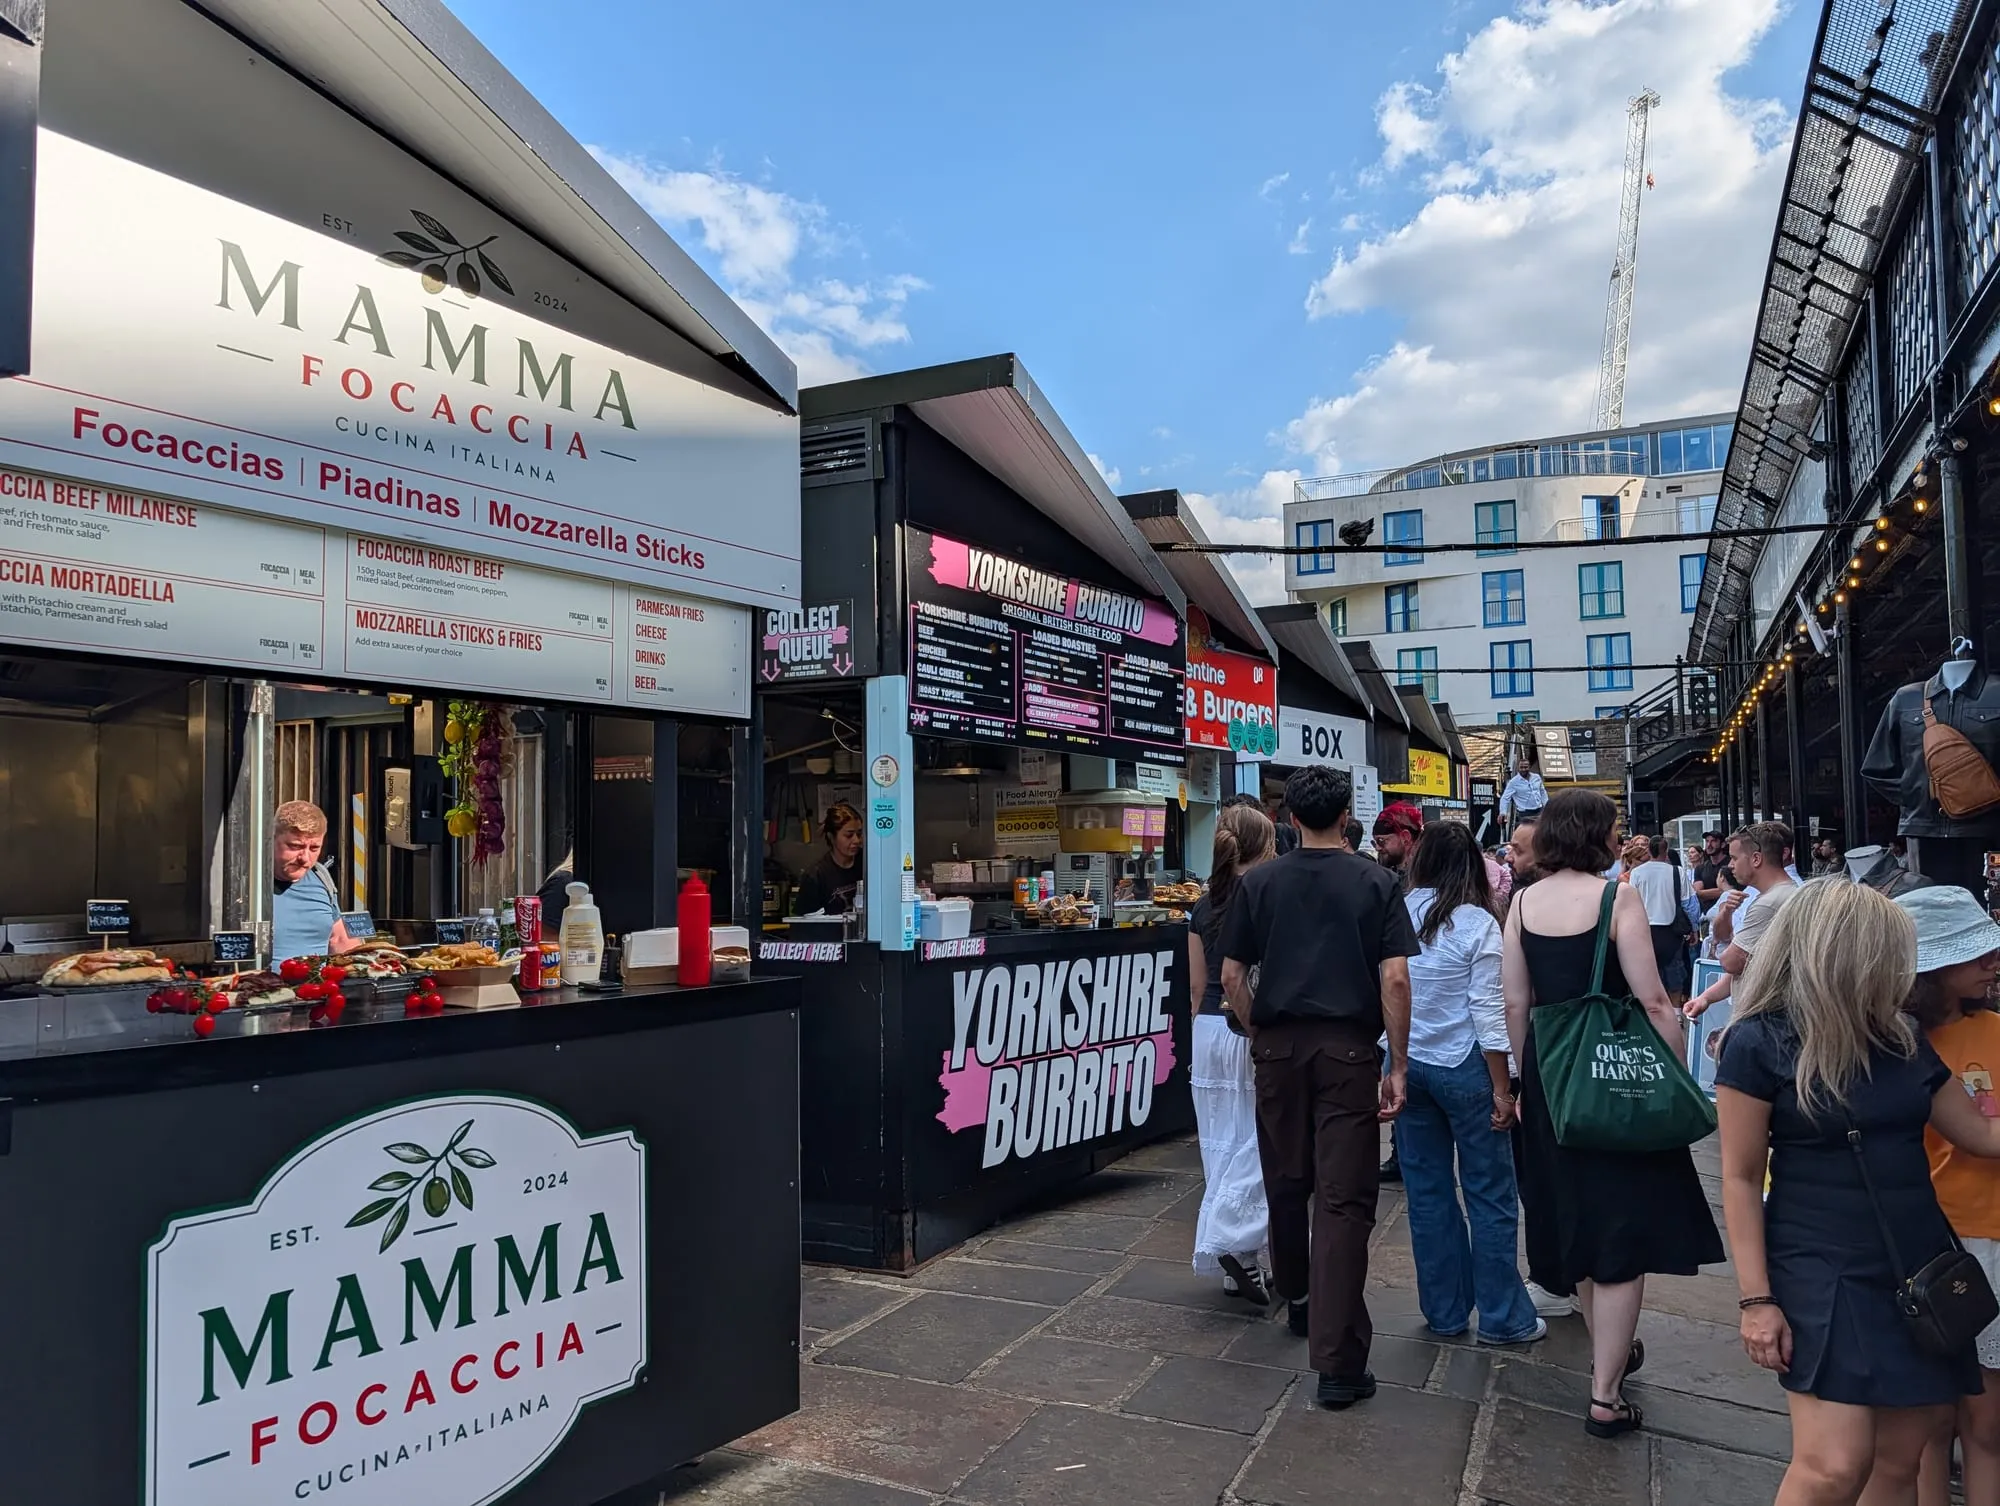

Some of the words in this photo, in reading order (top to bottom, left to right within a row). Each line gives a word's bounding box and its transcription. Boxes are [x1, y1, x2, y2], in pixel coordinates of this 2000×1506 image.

[323, 213, 357, 236] EST.
[534, 292, 568, 313] 2024
[215, 238, 639, 431] MAMMA
[301, 354, 589, 460] FOCACCIA
[335, 416, 436, 454] CUCINA
[451, 444, 556, 483] ITALIANA
[0, 473, 47, 501] CCIA
[53, 482, 101, 510] BEEF
[106, 492, 197, 528] MILANESE
[73, 406, 284, 481] Focaccias
[319, 462, 461, 518] Piadinas
[488, 500, 628, 554] Mozzarella
[635, 533, 705, 570] Sticks
[0, 507, 17, 518] eef,
[19, 510, 39, 520] rich
[41, 513, 78, 527] tomato
[80, 520, 110, 533] sauce,
[3, 518, 23, 528] and
[26, 520, 53, 532] Fresh
[55, 525, 74, 536] mix
[76, 529, 102, 540] salad
[260, 563, 289, 575] FOCACCIA
[300, 569, 316, 579] MEAL
[357, 538, 425, 568] FOCACCIA
[428, 551, 471, 575] ROAST
[474, 559, 505, 581] BEEF
[0, 559, 44, 586] CCIA
[51, 566, 175, 603] MORTADELLA
[357, 565, 375, 578] 150g
[376, 569, 396, 580] Roast
[398, 572, 414, 582] Beef,
[416, 575, 456, 589] caramelised
[457, 583, 480, 593] onions,
[357, 575, 379, 584] mixed
[380, 578, 401, 588] salad,
[402, 583, 432, 593] pecorino
[434, 588, 454, 596] cream
[967, 547, 1070, 613] YORKSHIRE
[1074, 580, 1145, 634] BURRITO
[0, 603, 43, 617] istachio,
[45, 608, 94, 622] Parmesan
[96, 616, 114, 625] and
[117, 616, 142, 628] Fresh
[144, 620, 168, 630] salad
[2, 593, 26, 604] with
[28, 595, 74, 610] Pistachio
[76, 603, 105, 613] cream
[108, 607, 126, 616] and
[636, 599, 681, 619] PARMESAN
[682, 605, 704, 623] FRIES
[917, 600, 967, 624] YORKSHIRE
[968, 613, 1009, 634] BURRITOS
[356, 609, 446, 639] MOZZARELLA
[450, 623, 494, 645] STICKS
[498, 629, 506, 646] &
[509, 635, 542, 652] FRIES
[635, 623, 667, 640] CHEESE
[766, 604, 840, 636] COLLECT
[918, 623, 935, 635] BEEF
[1001, 603, 1041, 623] ORIGINAL
[1042, 614, 1073, 631] BRITISH
[1074, 622, 1101, 638] STREET
[1101, 630, 1122, 642] FOOD
[259, 638, 289, 649] FOCACCIA
[300, 643, 316, 653] MEAL
[355, 637, 371, 646] Add
[372, 640, 390, 649] extra
[392, 643, 414, 651] sauces
[416, 644, 424, 652] of
[425, 647, 440, 655] your
[441, 648, 463, 657] choice
[778, 634, 833, 664] QUEUE
[918, 643, 947, 658] CHICKEN
[1032, 629, 1060, 646] LOADED
[1062, 638, 1097, 654] ROASTIES
[635, 649, 666, 666] DRINKS
[1125, 652, 1149, 667] LOADED
[1150, 659, 1169, 672] MASH
[635, 675, 657, 690] BEER
[917, 662, 938, 675] CAULI
[939, 666, 964, 680] CHEESE
[1186, 661, 1226, 686] entine
[1186, 687, 1198, 718] &
[1204, 689, 1273, 727] Burgers
[1301, 723, 1344, 760] BOX
[1005, 790, 1026, 799] Food
[541, 952, 560, 964] ANT
[760, 942, 809, 961] COLLECT
[810, 943, 842, 961] HERE
[929, 940, 958, 959] ORDER
[959, 938, 981, 956] HERE
[951, 950, 1174, 1070] YORKSHIRE
[1591, 1061, 1665, 1082] HARVST
[982, 1039, 1156, 1169] BURRITO
[523, 1170, 570, 1194] 2024
[269, 1225, 320, 1251] EST.
[197, 1212, 624, 1406] MAMMA
[251, 1322, 585, 1465] FOCACCIA
[295, 1442, 410, 1500] CUCINA
[427, 1394, 550, 1454] ITALIANA
